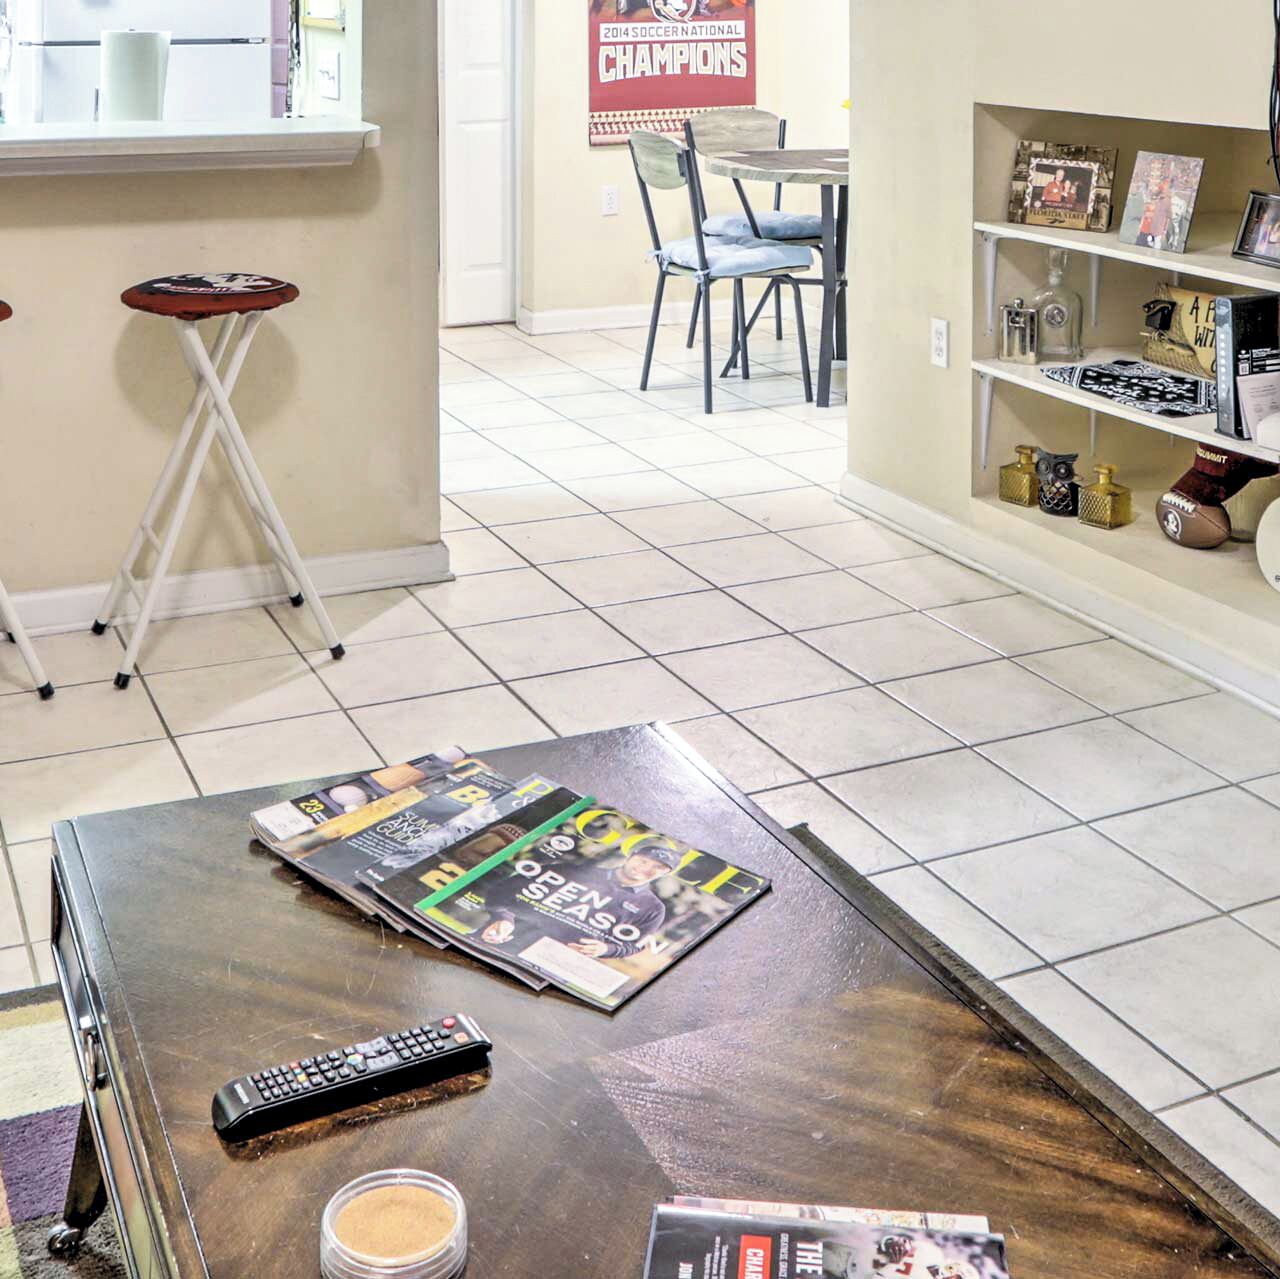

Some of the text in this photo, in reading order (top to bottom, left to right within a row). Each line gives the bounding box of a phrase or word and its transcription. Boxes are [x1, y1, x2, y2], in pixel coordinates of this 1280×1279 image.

[604, 25, 741, 39] 2014 SOCCER NATIONAL
[599, 41, 747, 83] CHAMPIONS
[1189, 295, 1200, 323] A
[1194, 325, 1216, 347] WIT
[299, 799, 325, 814] 23
[399, 811, 439, 832] SUM
[575, 809, 764, 898] GOLF
[514, 859, 613, 910] OPEN
[521, 882, 669, 954] SEASON
[745, 1247, 764, 1279] CHAR
[796, 1242, 823, 1276] THE
